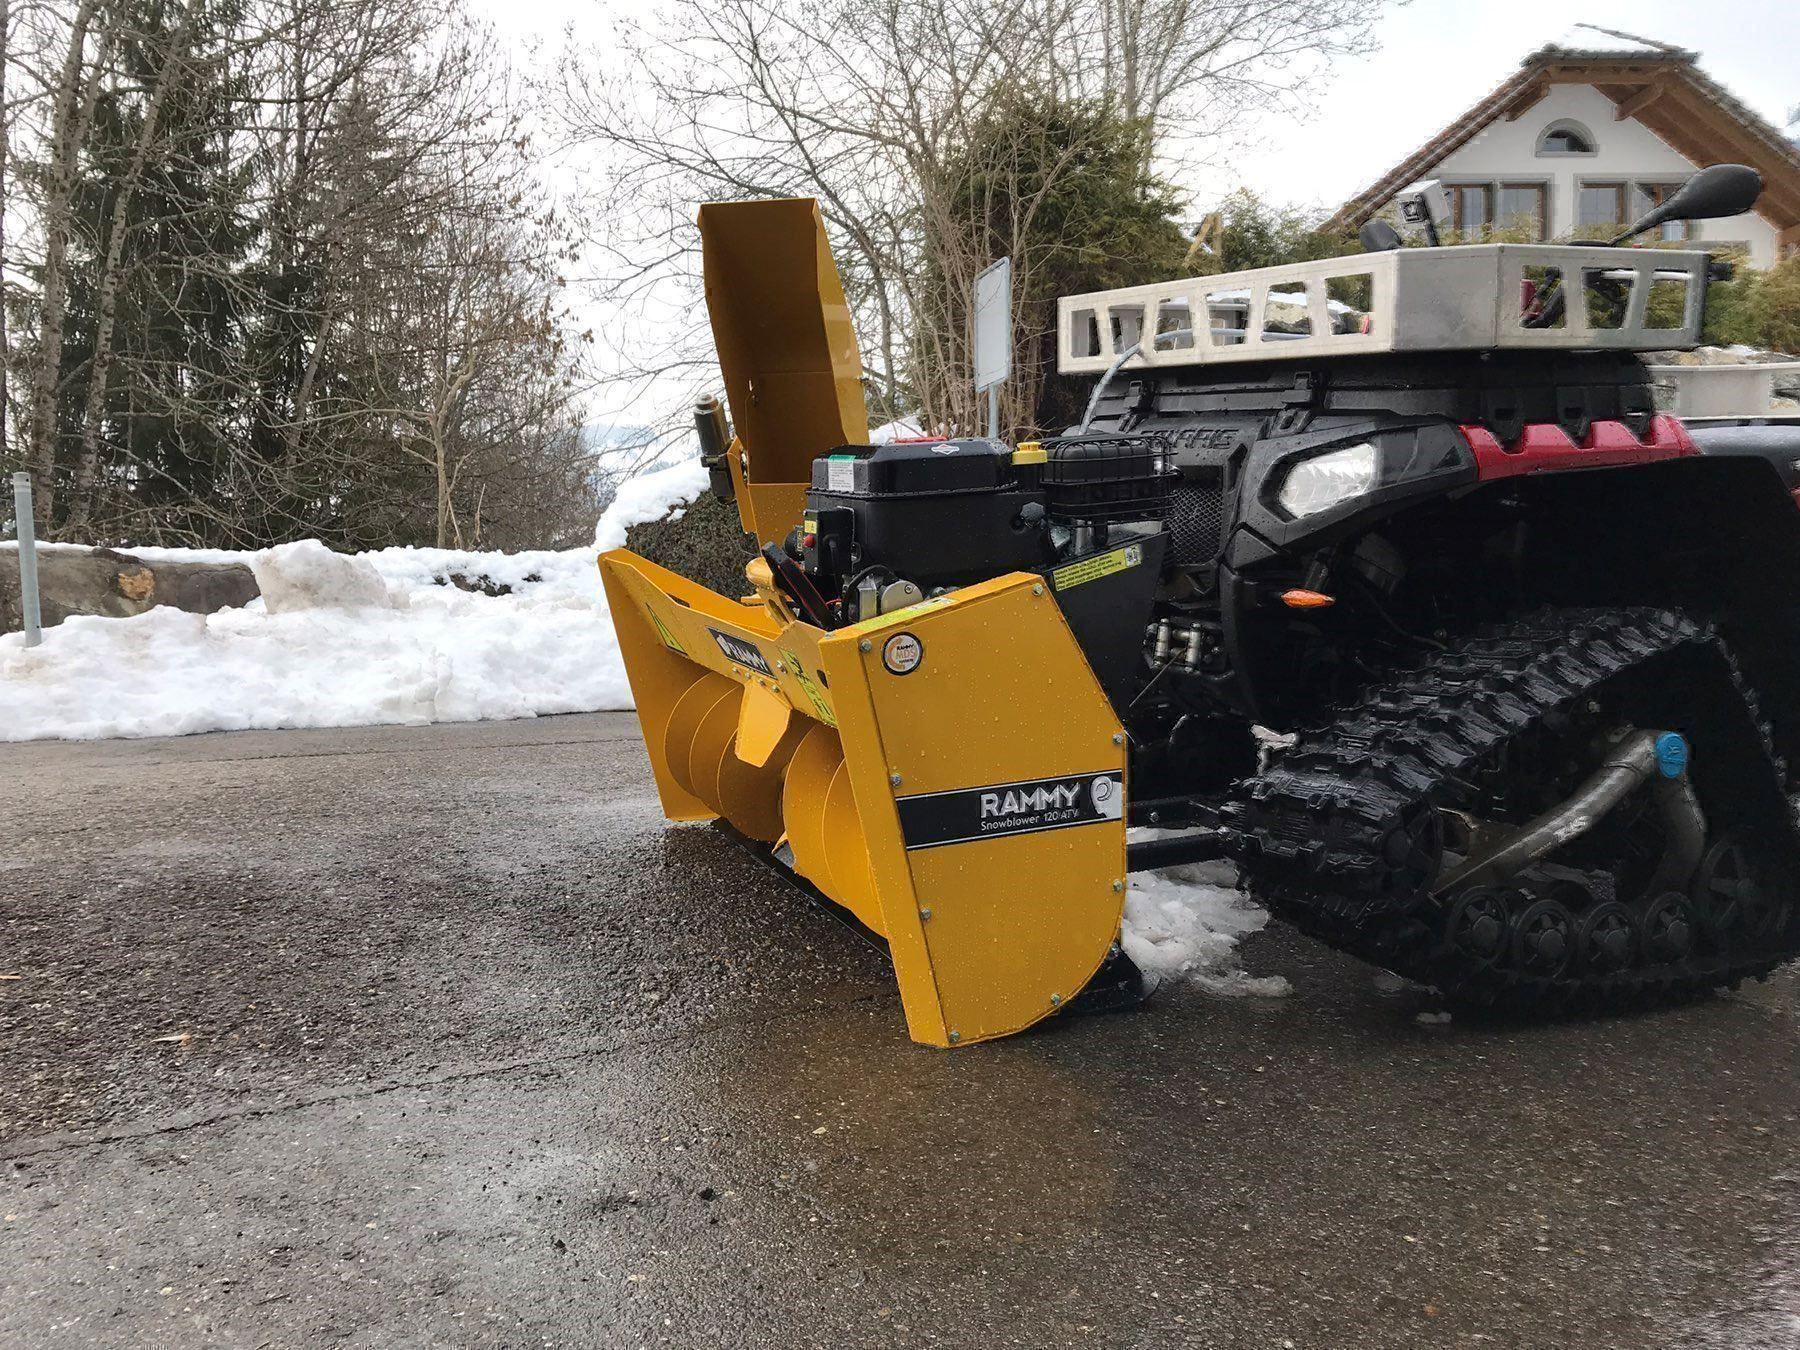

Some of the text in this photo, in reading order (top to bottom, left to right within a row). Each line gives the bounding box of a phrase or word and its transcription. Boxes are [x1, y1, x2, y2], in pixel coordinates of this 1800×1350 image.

[980, 781, 1080, 819] RAMMY
[980, 808, 1079, 832] Snowblower 120 ATV
